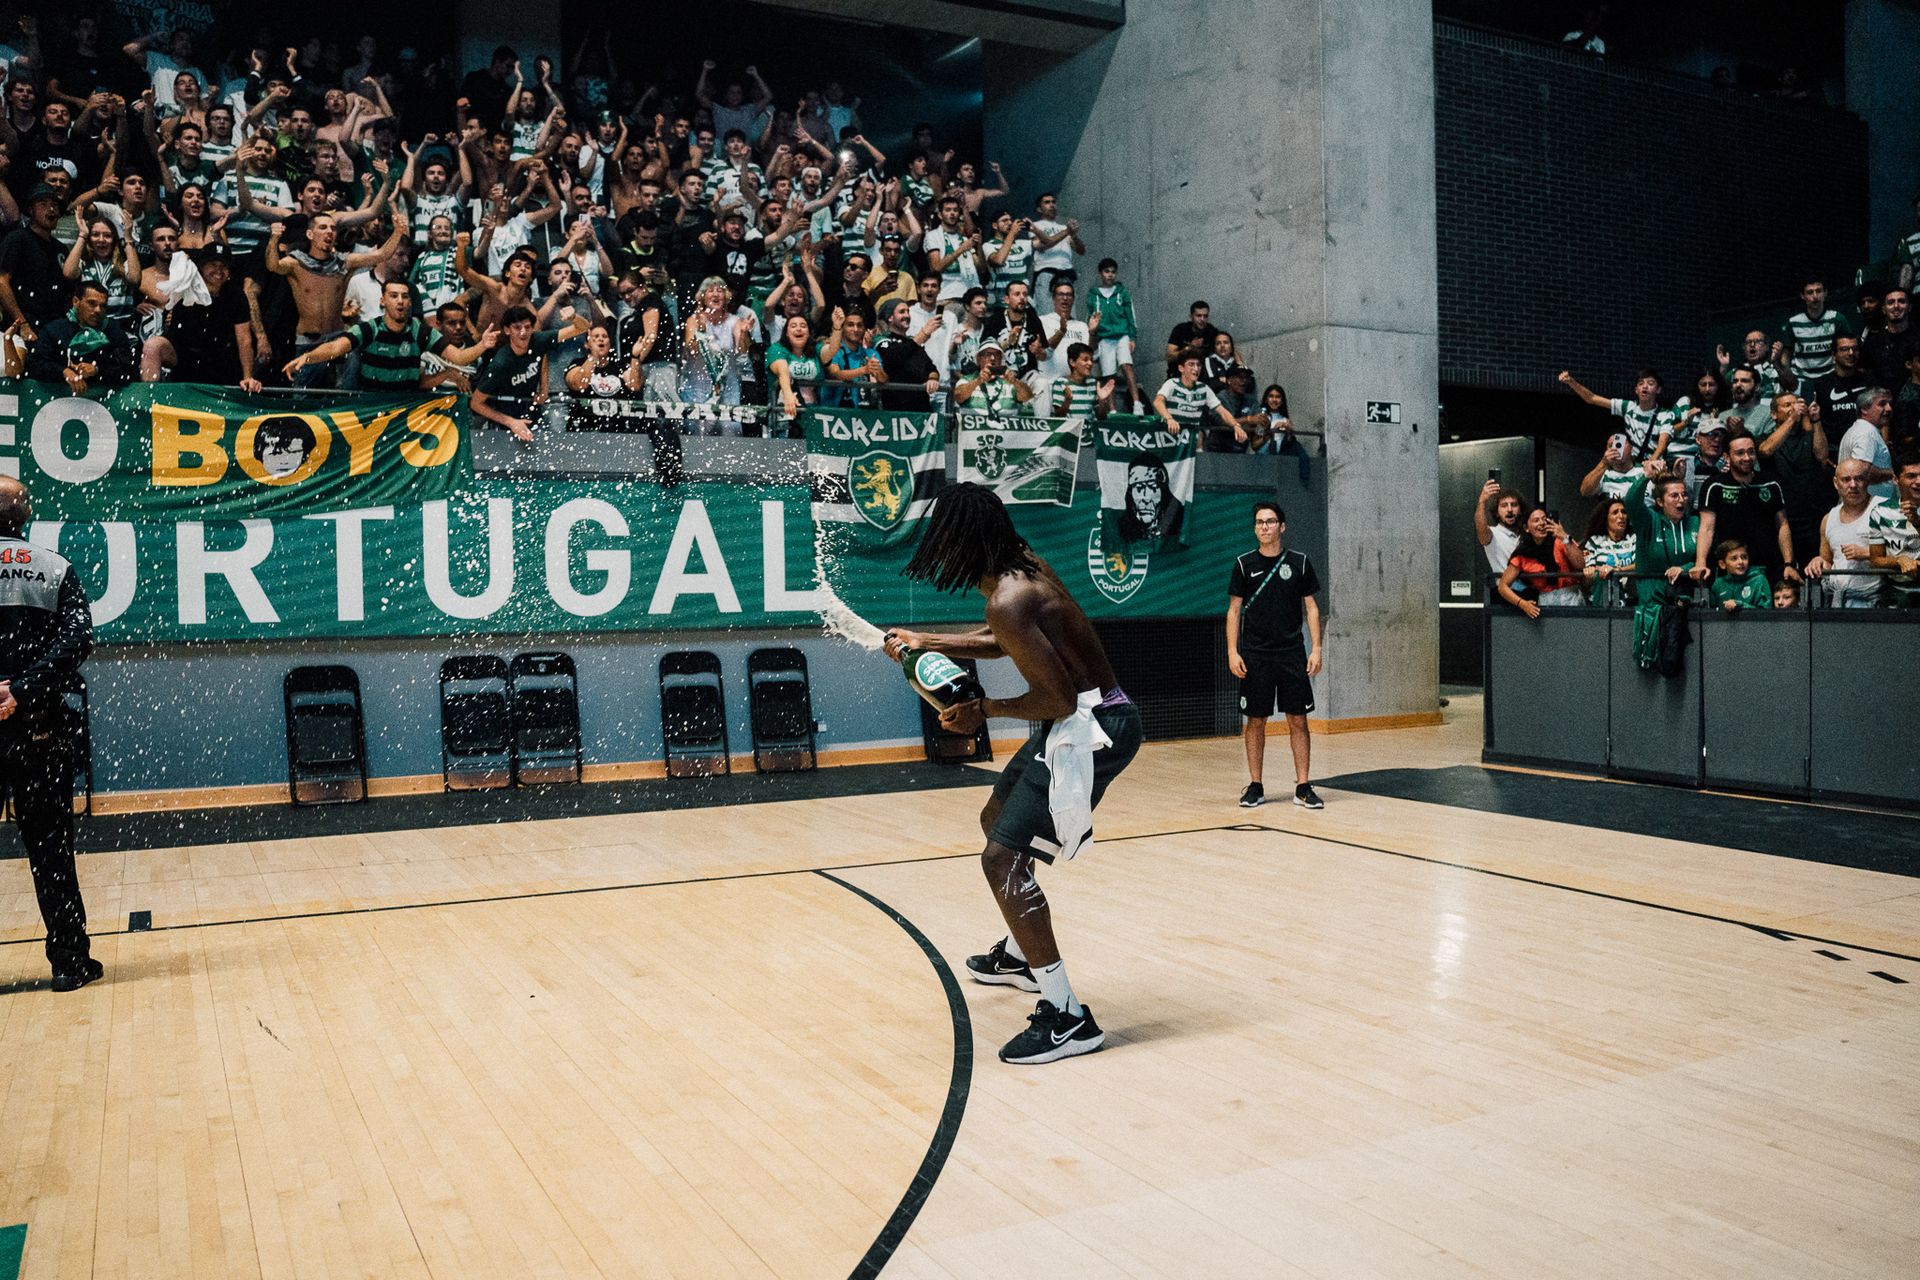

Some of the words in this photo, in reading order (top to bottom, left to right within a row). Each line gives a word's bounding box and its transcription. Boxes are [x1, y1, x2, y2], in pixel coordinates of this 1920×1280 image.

[151, 395, 459, 487] BOYS
[815, 413, 938, 447] TORCIDA
[976, 434, 1004, 447] SCP
[1098, 578, 1140, 593] PORTUGAL
